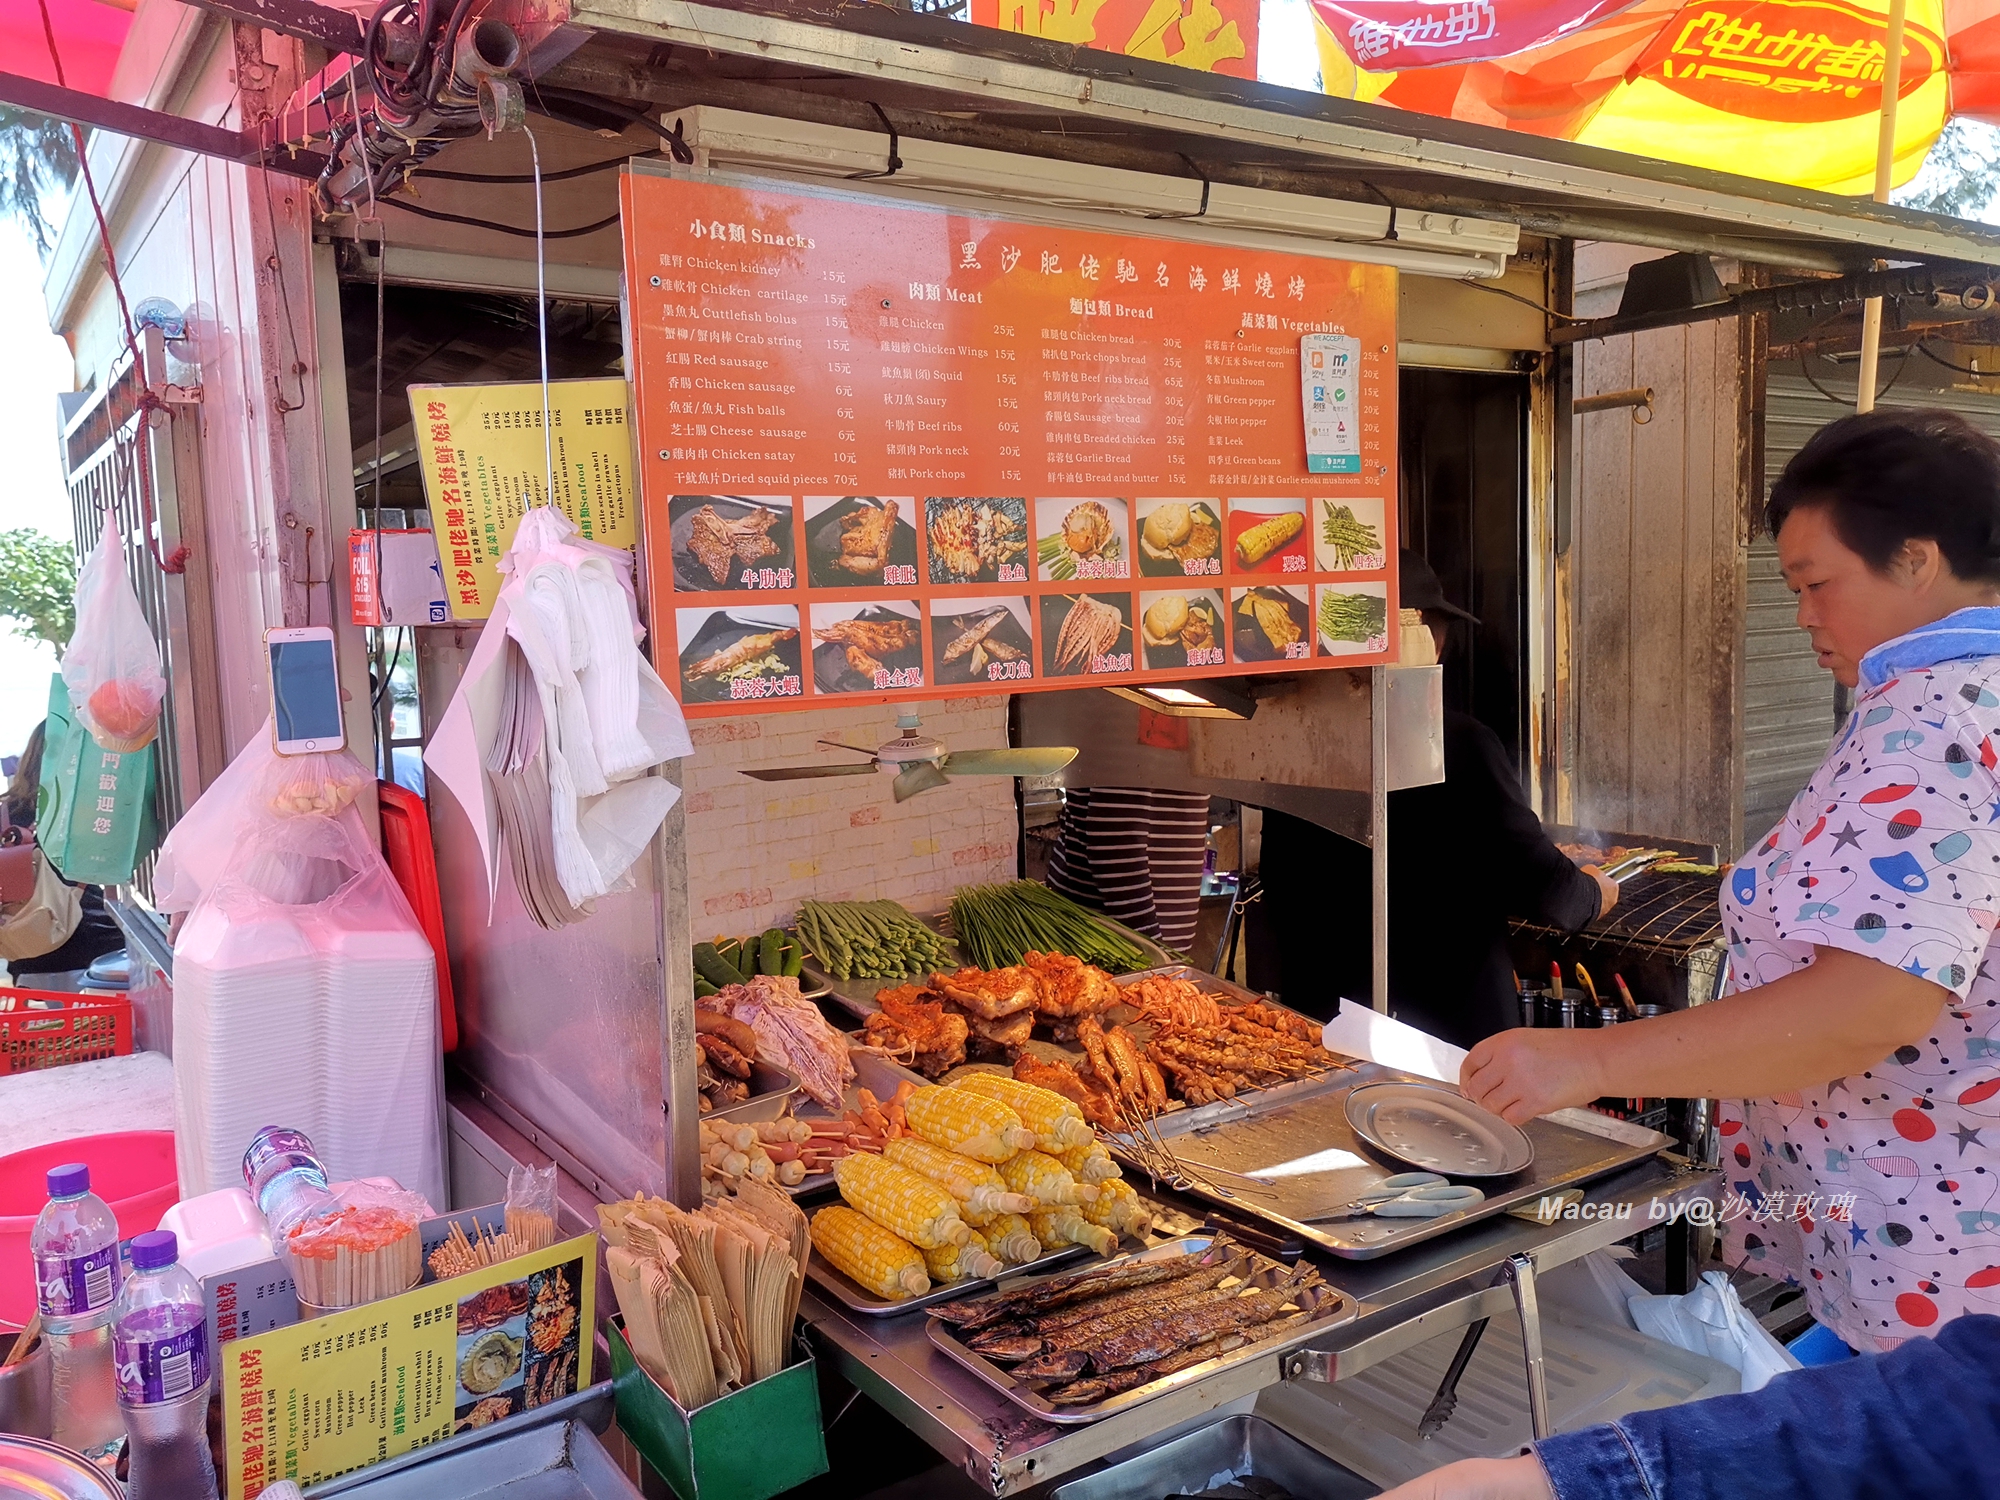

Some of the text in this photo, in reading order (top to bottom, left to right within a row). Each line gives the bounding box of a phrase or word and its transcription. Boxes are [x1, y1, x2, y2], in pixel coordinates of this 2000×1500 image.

[689, 219, 816, 249] 小食類 Snacks
[959, 241, 1305, 301] 黑沙肥佬馳名海鮮燒烤
[661, 279, 847, 306] 雞軟骨 Chicken cartilage 15元
[909, 282, 983, 303] 肉類 Meat
[662, 304, 848, 329] 墨魚丸 Cuttlefish bolus 15元
[1116, 304, 1153, 318] Bread
[1242, 312, 1345, 333] 蔬菜類 Vegetables
[736, 332, 764, 345] Crab
[768, 335, 802, 348] string
[826, 339, 849, 351] 15元
[694, 354, 716, 366] Red
[720, 358, 768, 369] sausage
[828, 362, 851, 374] 15元
[1042, 349, 1182, 368] 豬扒包 Pork chops bread 25元
[1223, 376, 1265, 386] Mushroom
[1364, 388, 1379, 397] 15元
[884, 393, 1017, 408] 秋刀魚 Saury 15元
[553, 410, 561, 426] 50元
[669, 401, 853, 419] 魚蛋/魚丸 Fish balls 6元
[482, 412, 490, 430] 25元
[492, 412, 500, 429] 20元
[502, 412, 511, 428] 15元
[512, 411, 520, 428] 20元
[918, 421, 940, 431] Beef
[943, 421, 962, 432] ribs
[998, 423, 1019, 433] 60元
[1225, 416, 1238, 425] Hot
[1240, 418, 1266, 427] pepper
[1364, 423, 1379, 433] 20元
[710, 425, 753, 438] Cheese
[760, 428, 807, 439] sausage
[838, 430, 855, 441] 6元
[1084, 433, 1120, 443] Breaded
[1122, 435, 1156, 444] chicken
[1167, 436, 1185, 446] 25元
[559, 437, 568, 478] mushroom
[672, 448, 856, 464] 雞肉串 Chicken satay 10元
[920, 445, 942, 455] Pork
[946, 446, 969, 455] neck
[1000, 447, 1020, 457] 20元
[603, 454, 611, 483] prawns
[1209, 455, 1379, 468] 四季豆 Green beans 20元
[491, 466, 500, 500] eggplant
[614, 464, 622, 493] octopus
[722, 472, 755, 484] Dried
[758, 473, 789, 486] squid
[792, 473, 828, 486] pieces
[834, 474, 858, 486] 70元
[888, 468, 1021, 480] 豬扒 Pork chops 15元
[478, 456, 492, 519] Vegetables
[533, 475, 541, 498] pepper
[428, 401, 480, 605] 黑沙肥佬馳名海鮮燒烤
[353, 557, 371, 575] FOIL
[1184, 557, 1220, 575] 豬扒包
[741, 568, 793, 589] 牛肋骨
[1286, 643, 1308, 658] 茄子
[988, 660, 1032, 680] 秋刀魚
[92, 752, 120, 834] 門歡迎您
[335, 1335, 343, 1352] 20元
[358, 1328, 366, 1345] 20元
[301, 1345, 309, 1362] 25元
[312, 1341, 320, 1358] 20元
[287, 1388, 298, 1447] Vegetables
